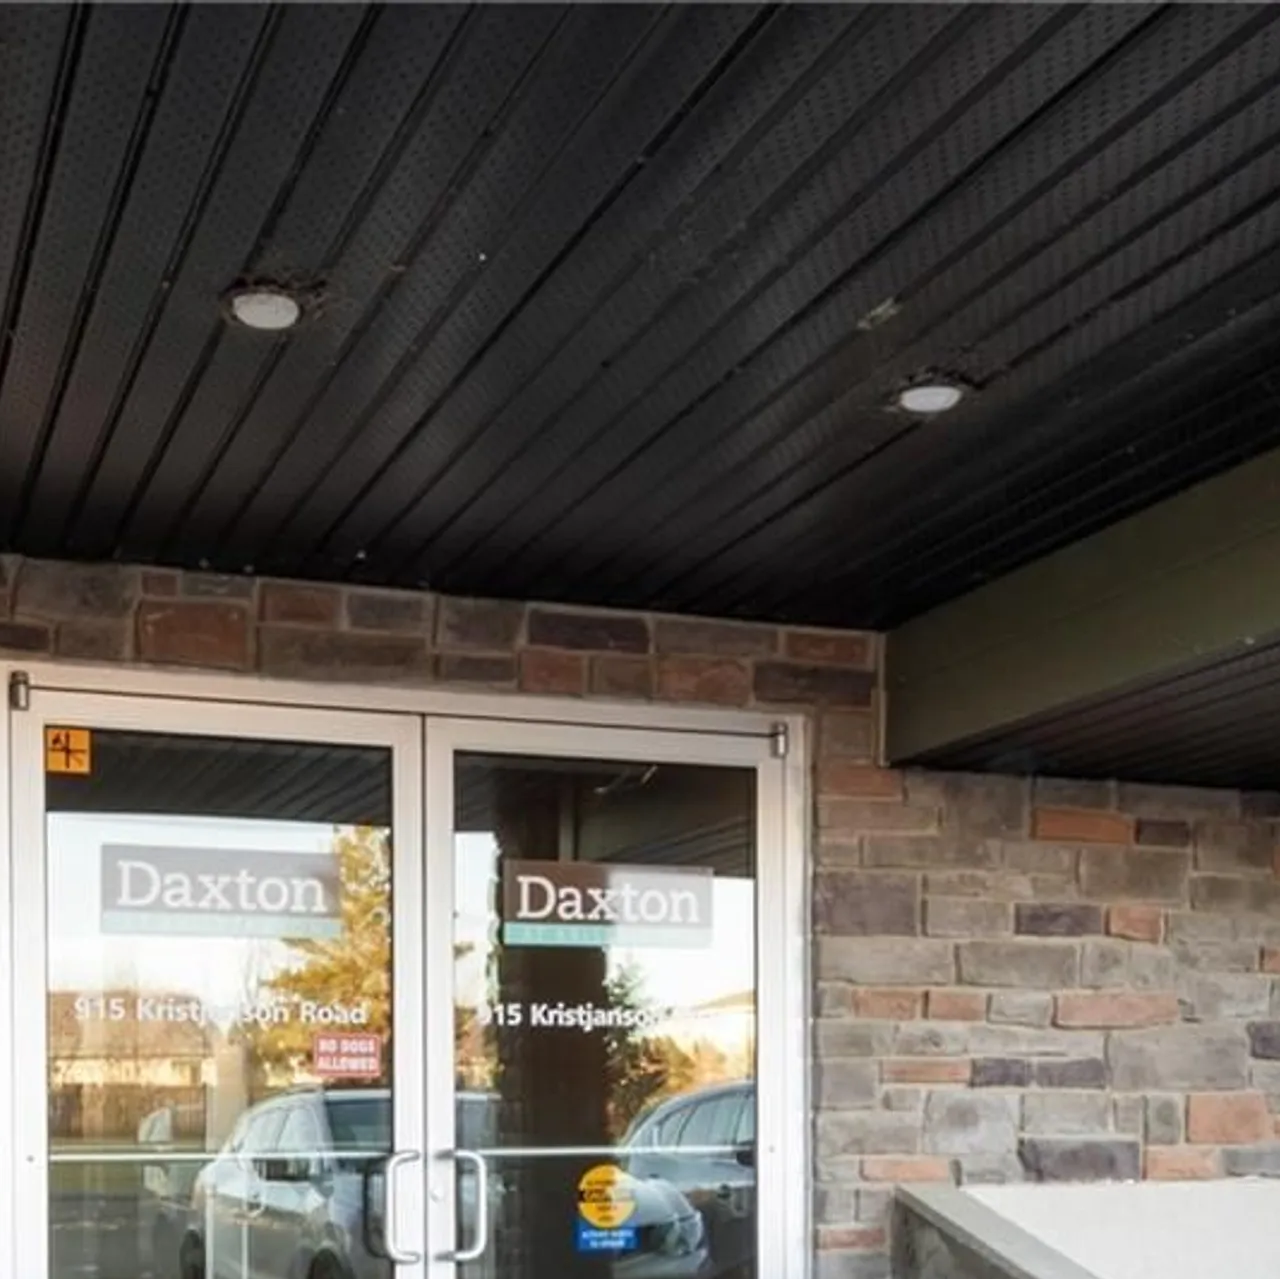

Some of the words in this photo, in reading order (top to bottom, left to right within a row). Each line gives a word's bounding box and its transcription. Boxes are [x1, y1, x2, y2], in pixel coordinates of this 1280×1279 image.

[116, 859, 328, 913] Daxton
[516, 875, 701, 924] Daxton
[73, 998, 126, 1021] 915
[135, 993, 291, 1026] Kristjson
[299, 999, 370, 1024] Road
[530, 1002, 662, 1032] Kristjanso
